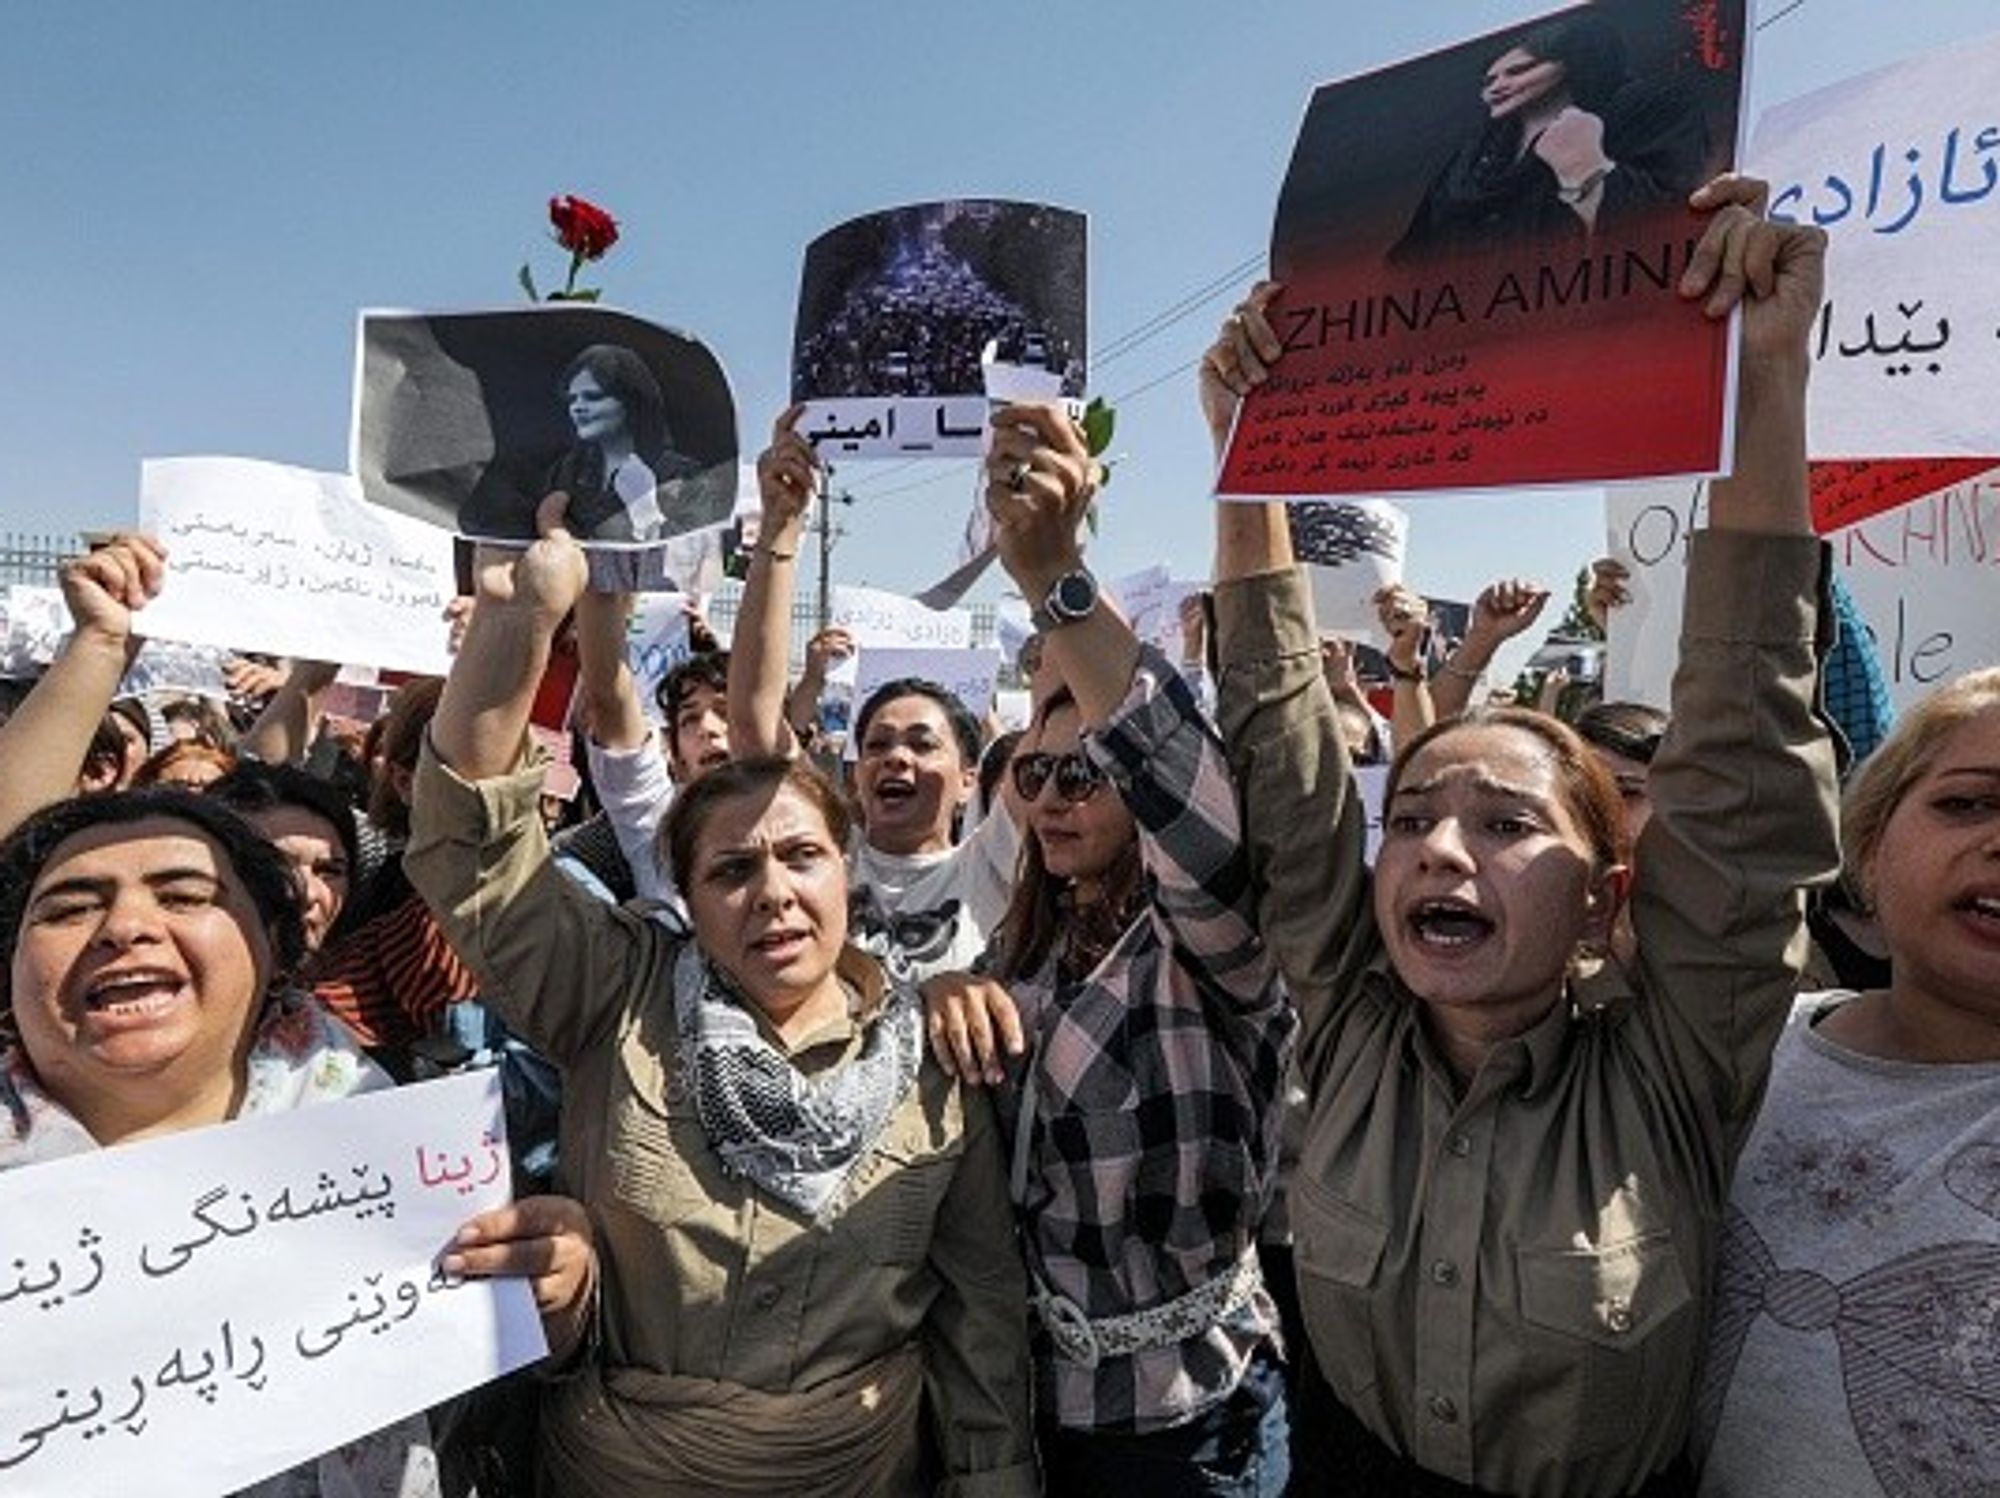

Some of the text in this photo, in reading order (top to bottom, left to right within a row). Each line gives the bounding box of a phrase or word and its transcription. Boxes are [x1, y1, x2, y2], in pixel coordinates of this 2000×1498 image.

[1282, 284, 1467, 352] ZHINA
[0, 1130, 501, 1311] ژینا پێشەنگی ژین
[295, 1271, 464, 1360] ەوێنی
